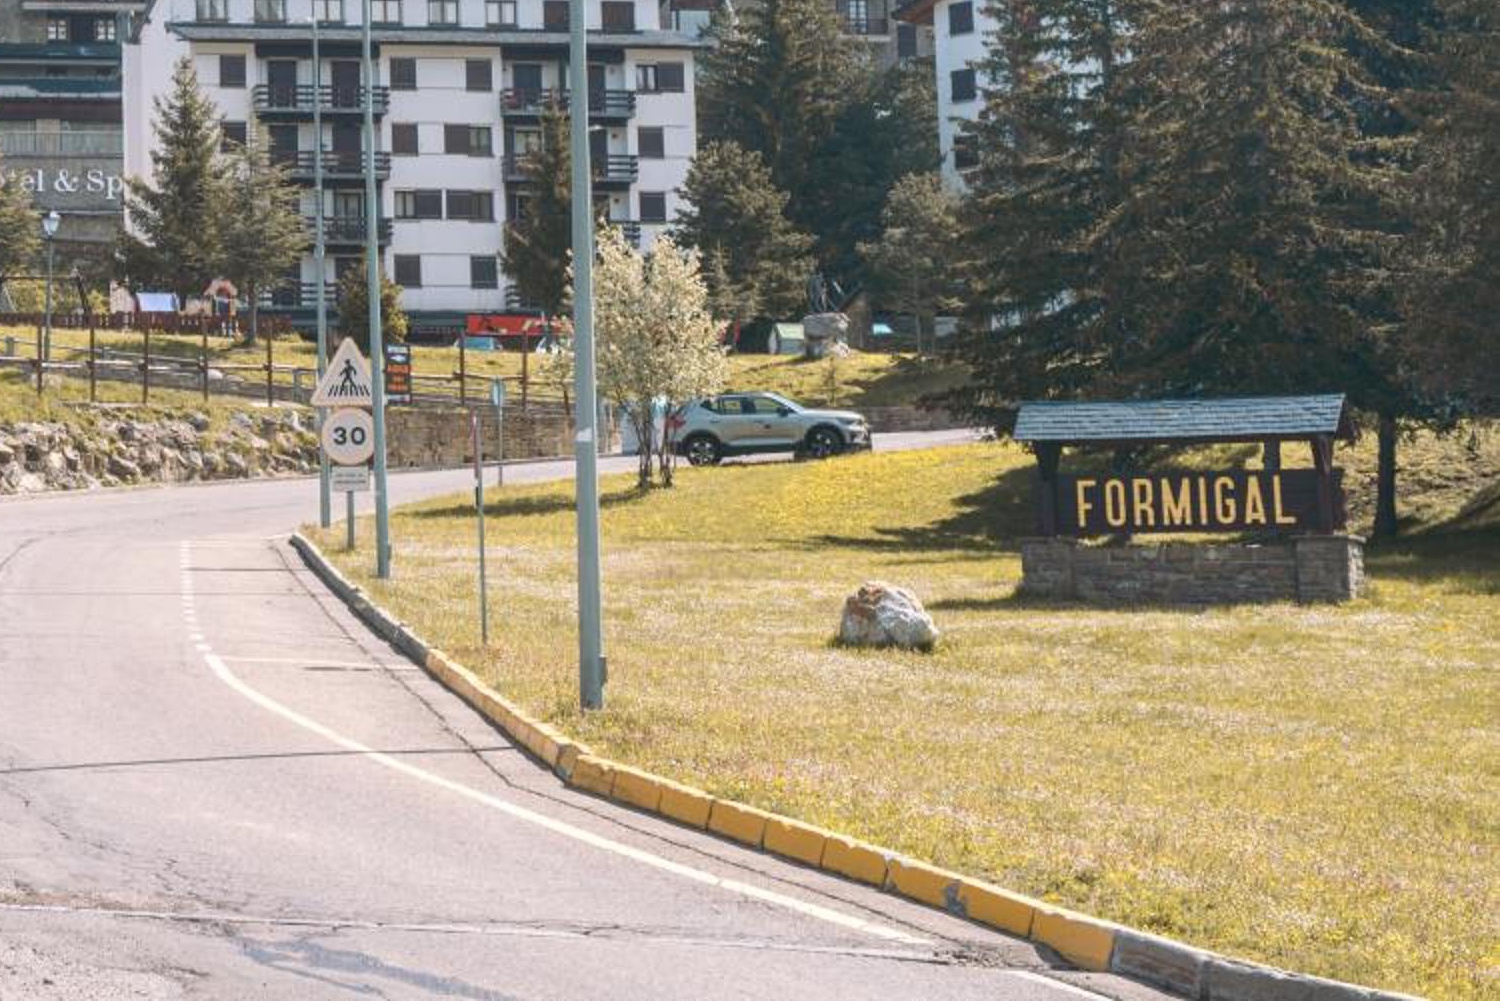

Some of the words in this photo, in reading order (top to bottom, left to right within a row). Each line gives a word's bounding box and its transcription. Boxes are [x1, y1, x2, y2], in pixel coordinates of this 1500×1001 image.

[53, 168, 79, 192] &
[86, 168, 123, 200] Sp
[332, 426, 367, 446] 30
[1075, 474, 1298, 528] FORMIGAL
